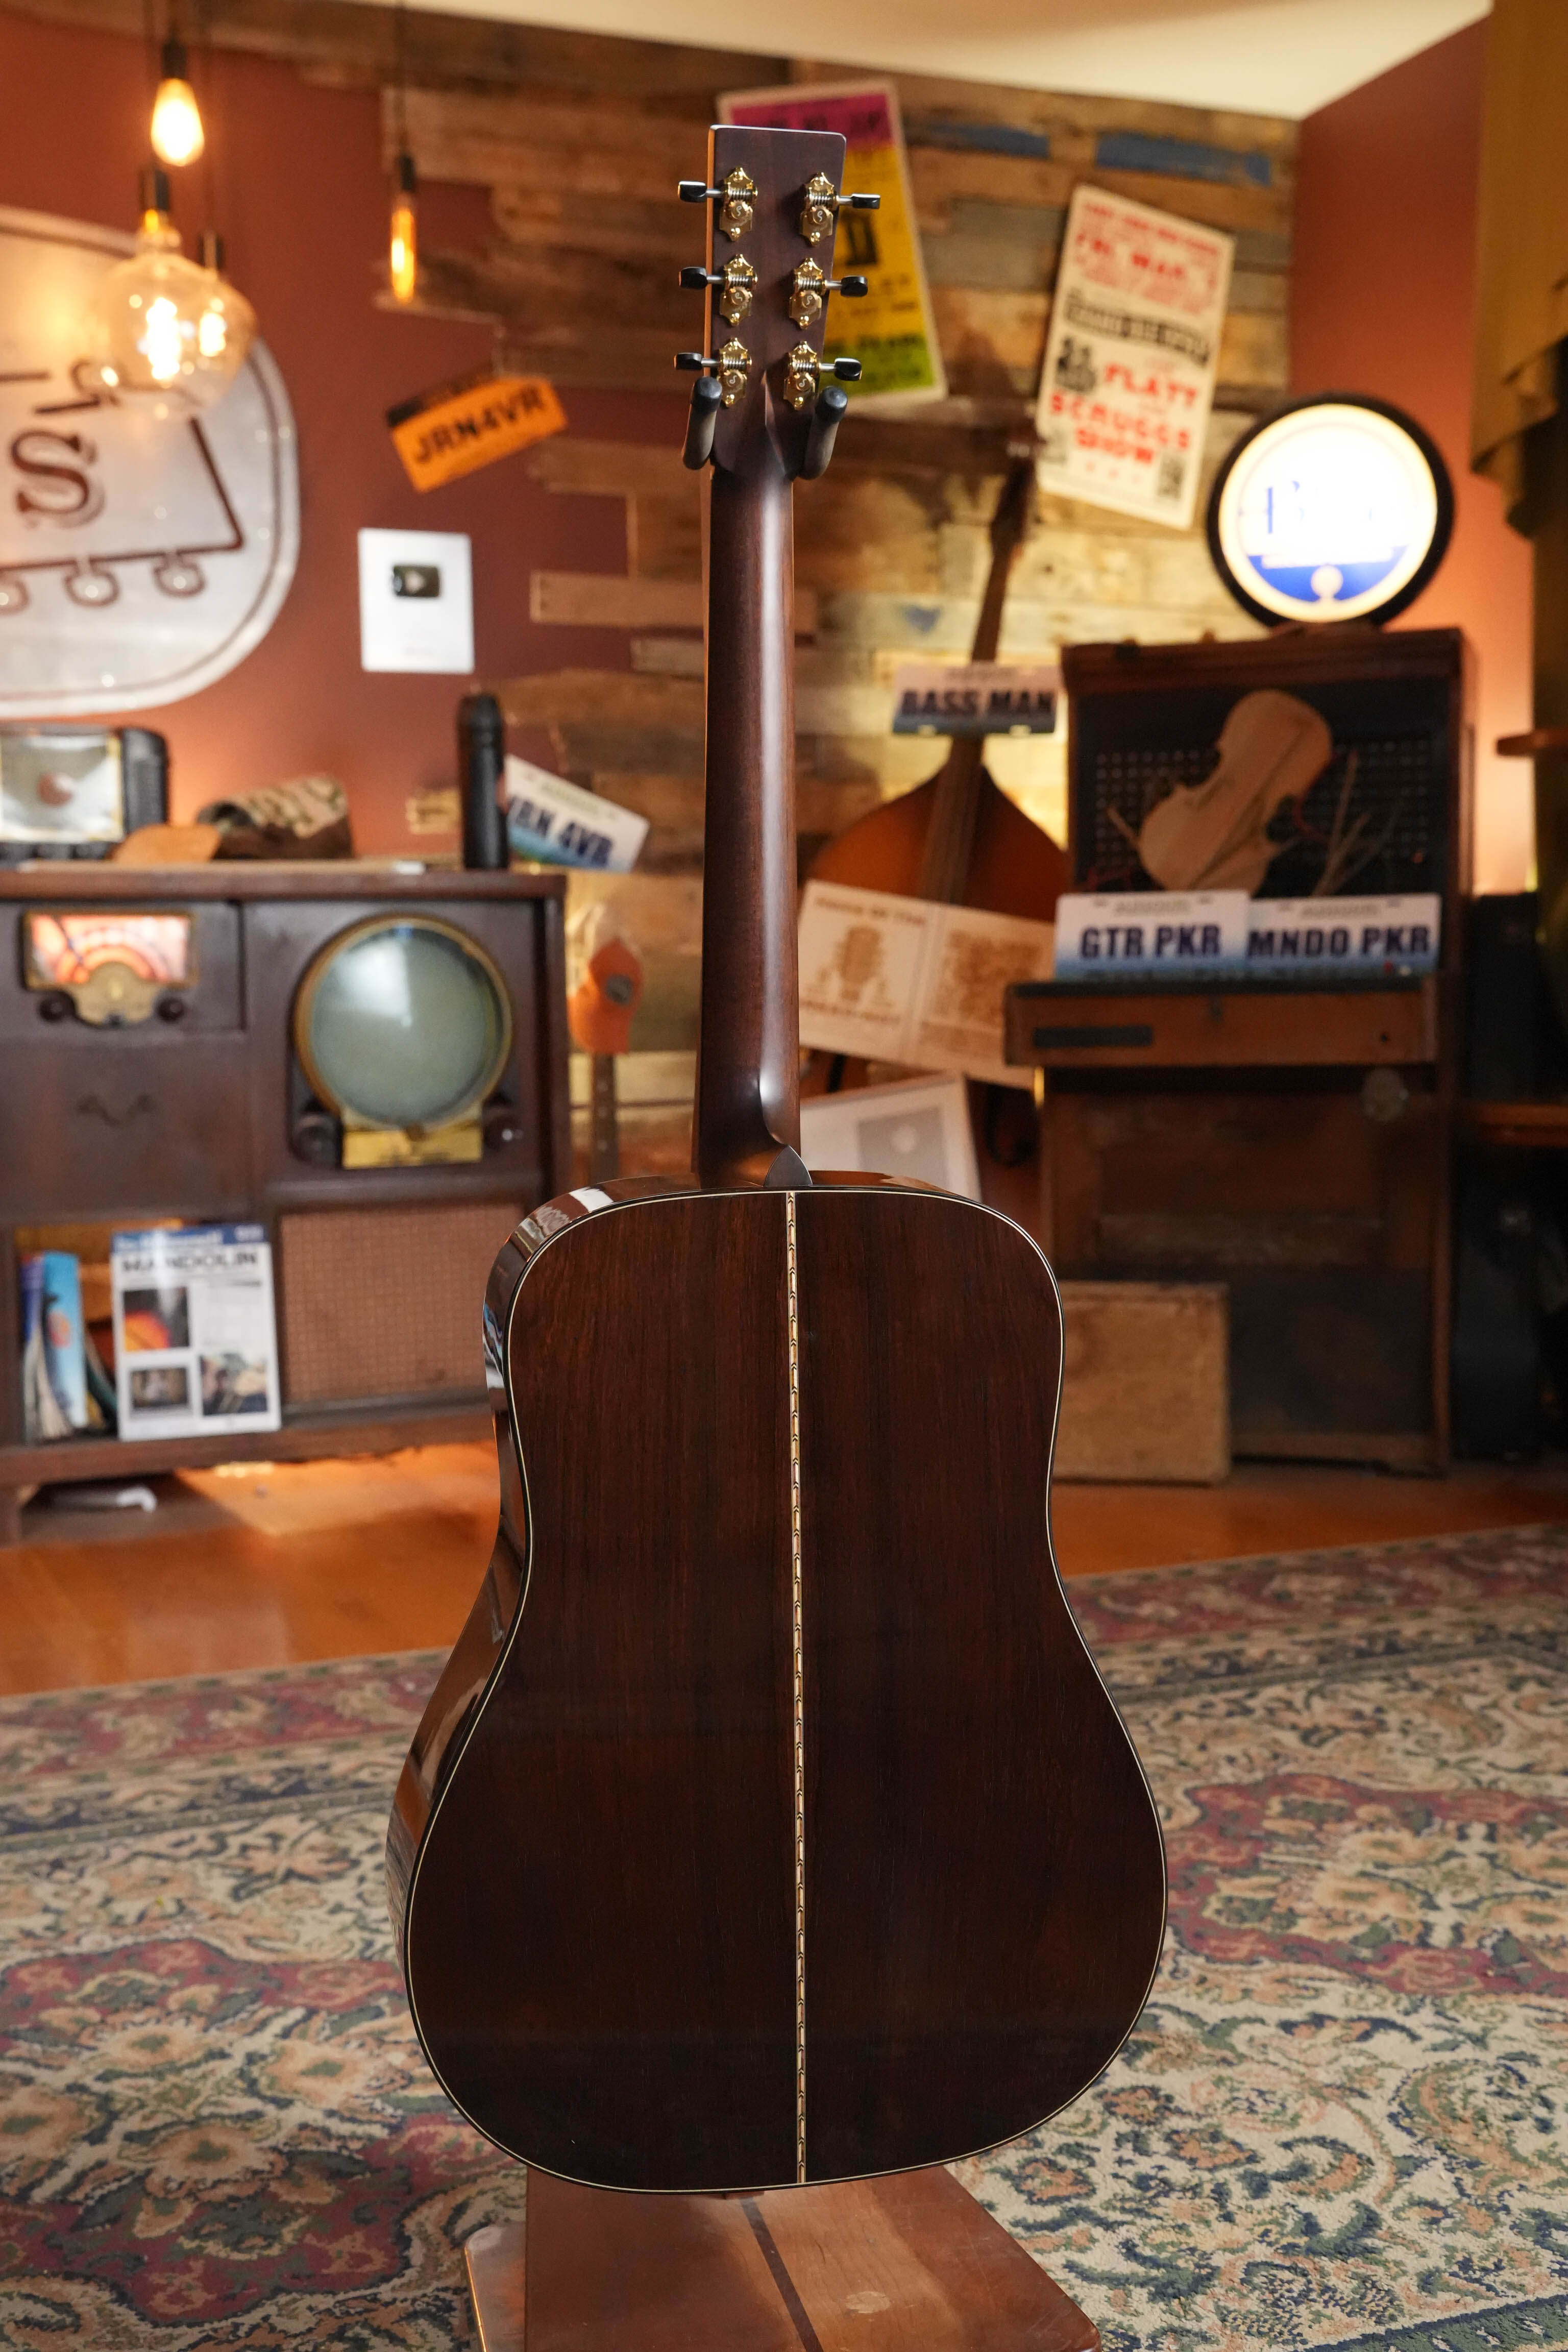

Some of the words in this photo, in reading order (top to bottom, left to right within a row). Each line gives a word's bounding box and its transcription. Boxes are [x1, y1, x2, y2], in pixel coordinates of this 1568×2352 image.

[1080, 925, 1143, 958] GTR
[1155, 924, 1221, 958] PKR
[1246, 928, 1349, 958] MNDO
[1362, 926, 1429, 957] PKR
